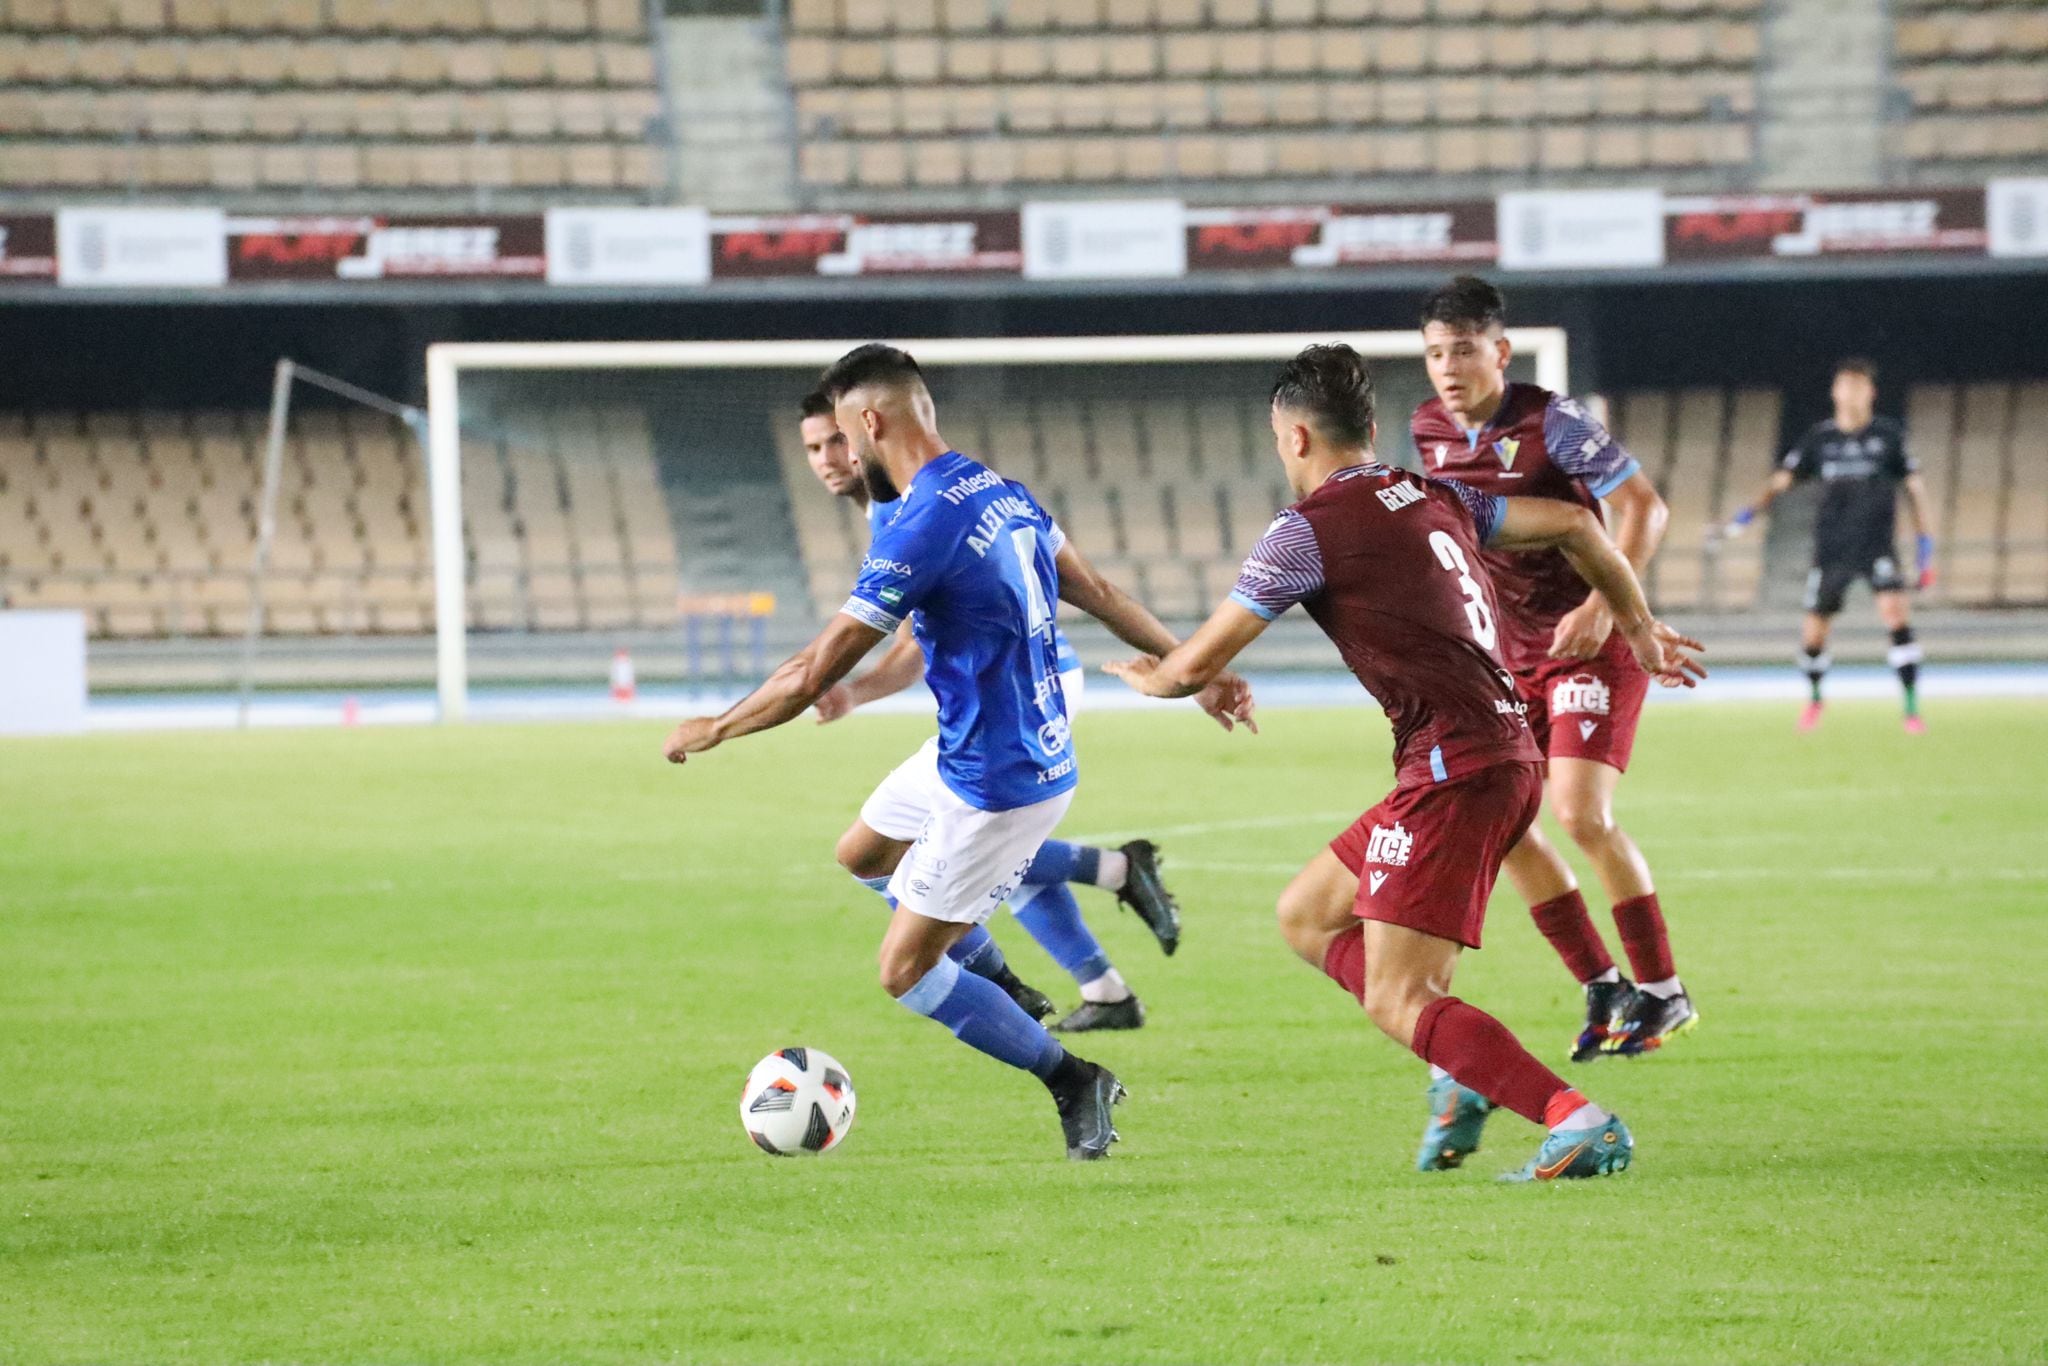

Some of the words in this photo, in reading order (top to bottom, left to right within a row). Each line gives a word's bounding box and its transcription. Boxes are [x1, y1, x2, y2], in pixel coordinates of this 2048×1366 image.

[966, 505, 1005, 558] ALEX
[1011, 526, 1054, 646] 4
[1428, 530, 1495, 651] 3
[1037, 757, 1072, 785] XEREZ
